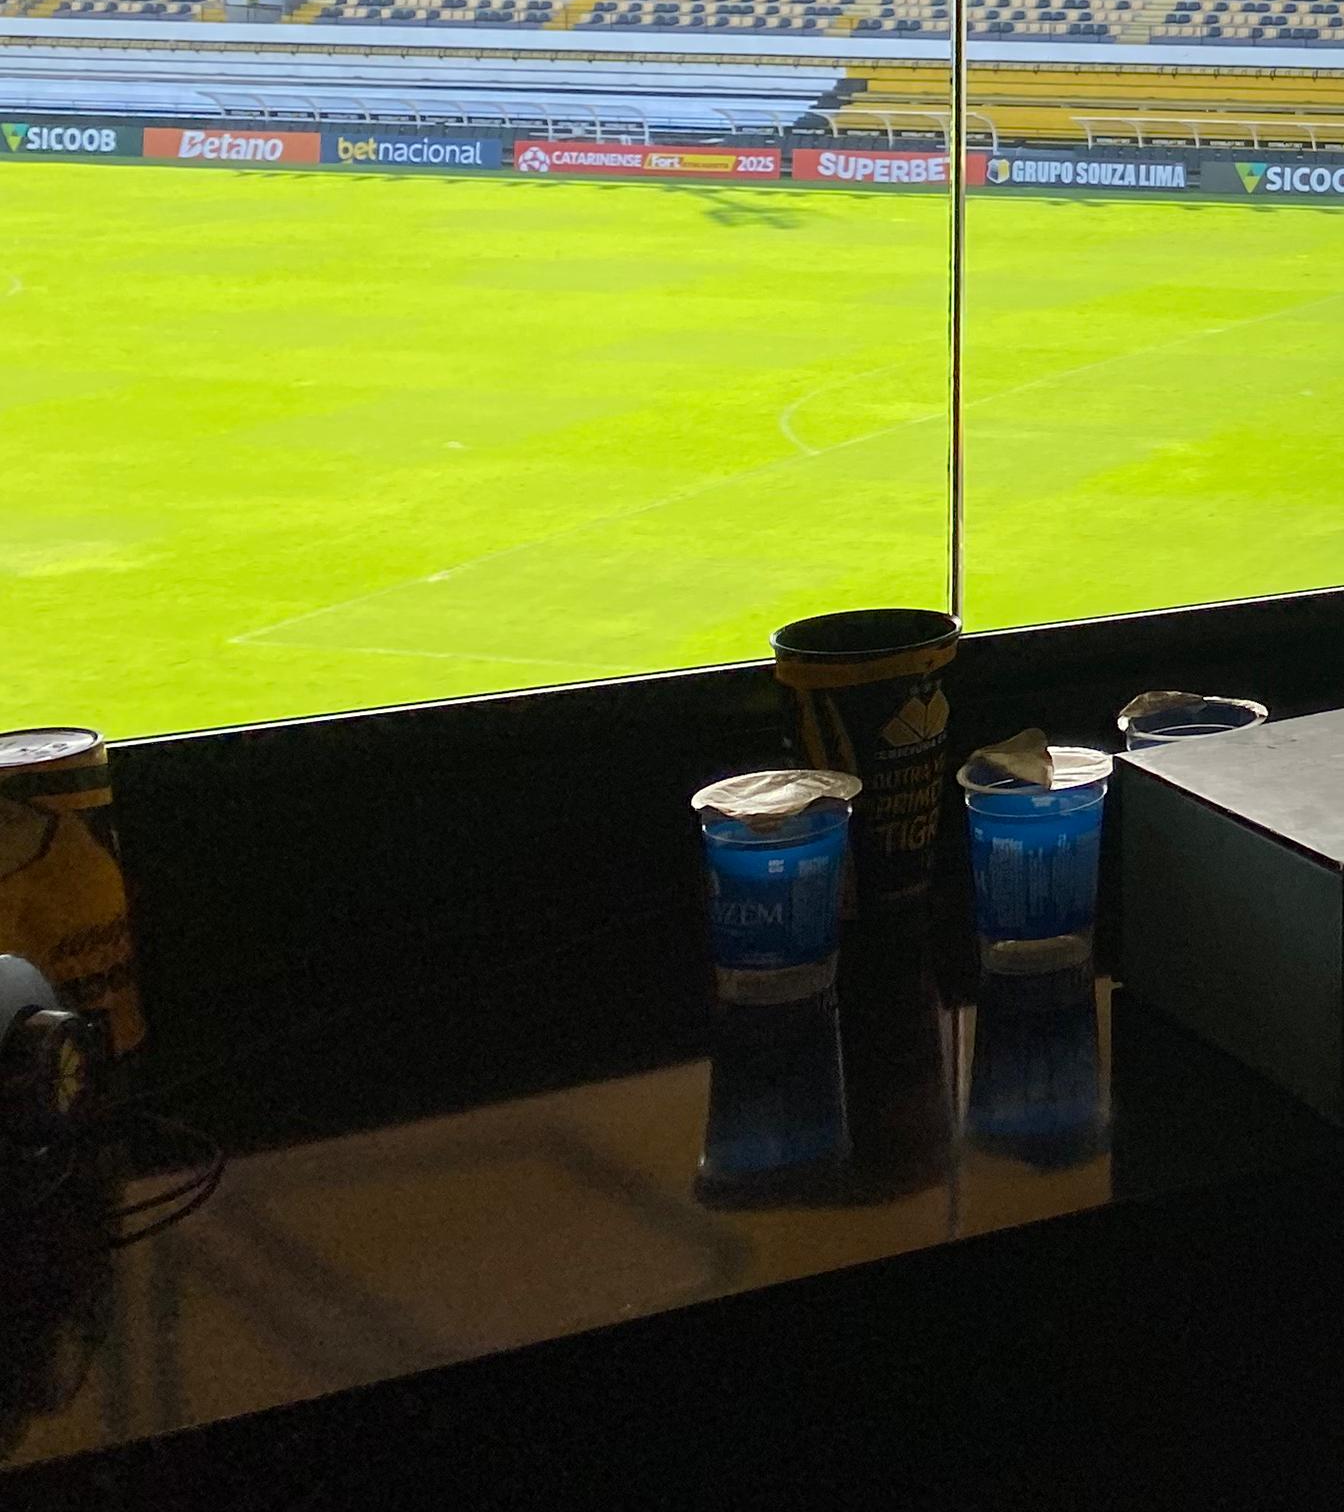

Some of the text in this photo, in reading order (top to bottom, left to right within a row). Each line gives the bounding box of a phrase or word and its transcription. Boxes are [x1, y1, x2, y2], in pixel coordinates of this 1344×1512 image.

[26, 127, 117, 152] SICOOB
[178, 129, 283, 160] Betano
[338, 137, 481, 165] betnacional
[552, 150, 642, 168] CATARINENSE
[650, 154, 682, 169] Fort
[737, 156, 775, 172] 2025
[1012, 160, 1186, 188] GRUPO SOUZA LIMA
